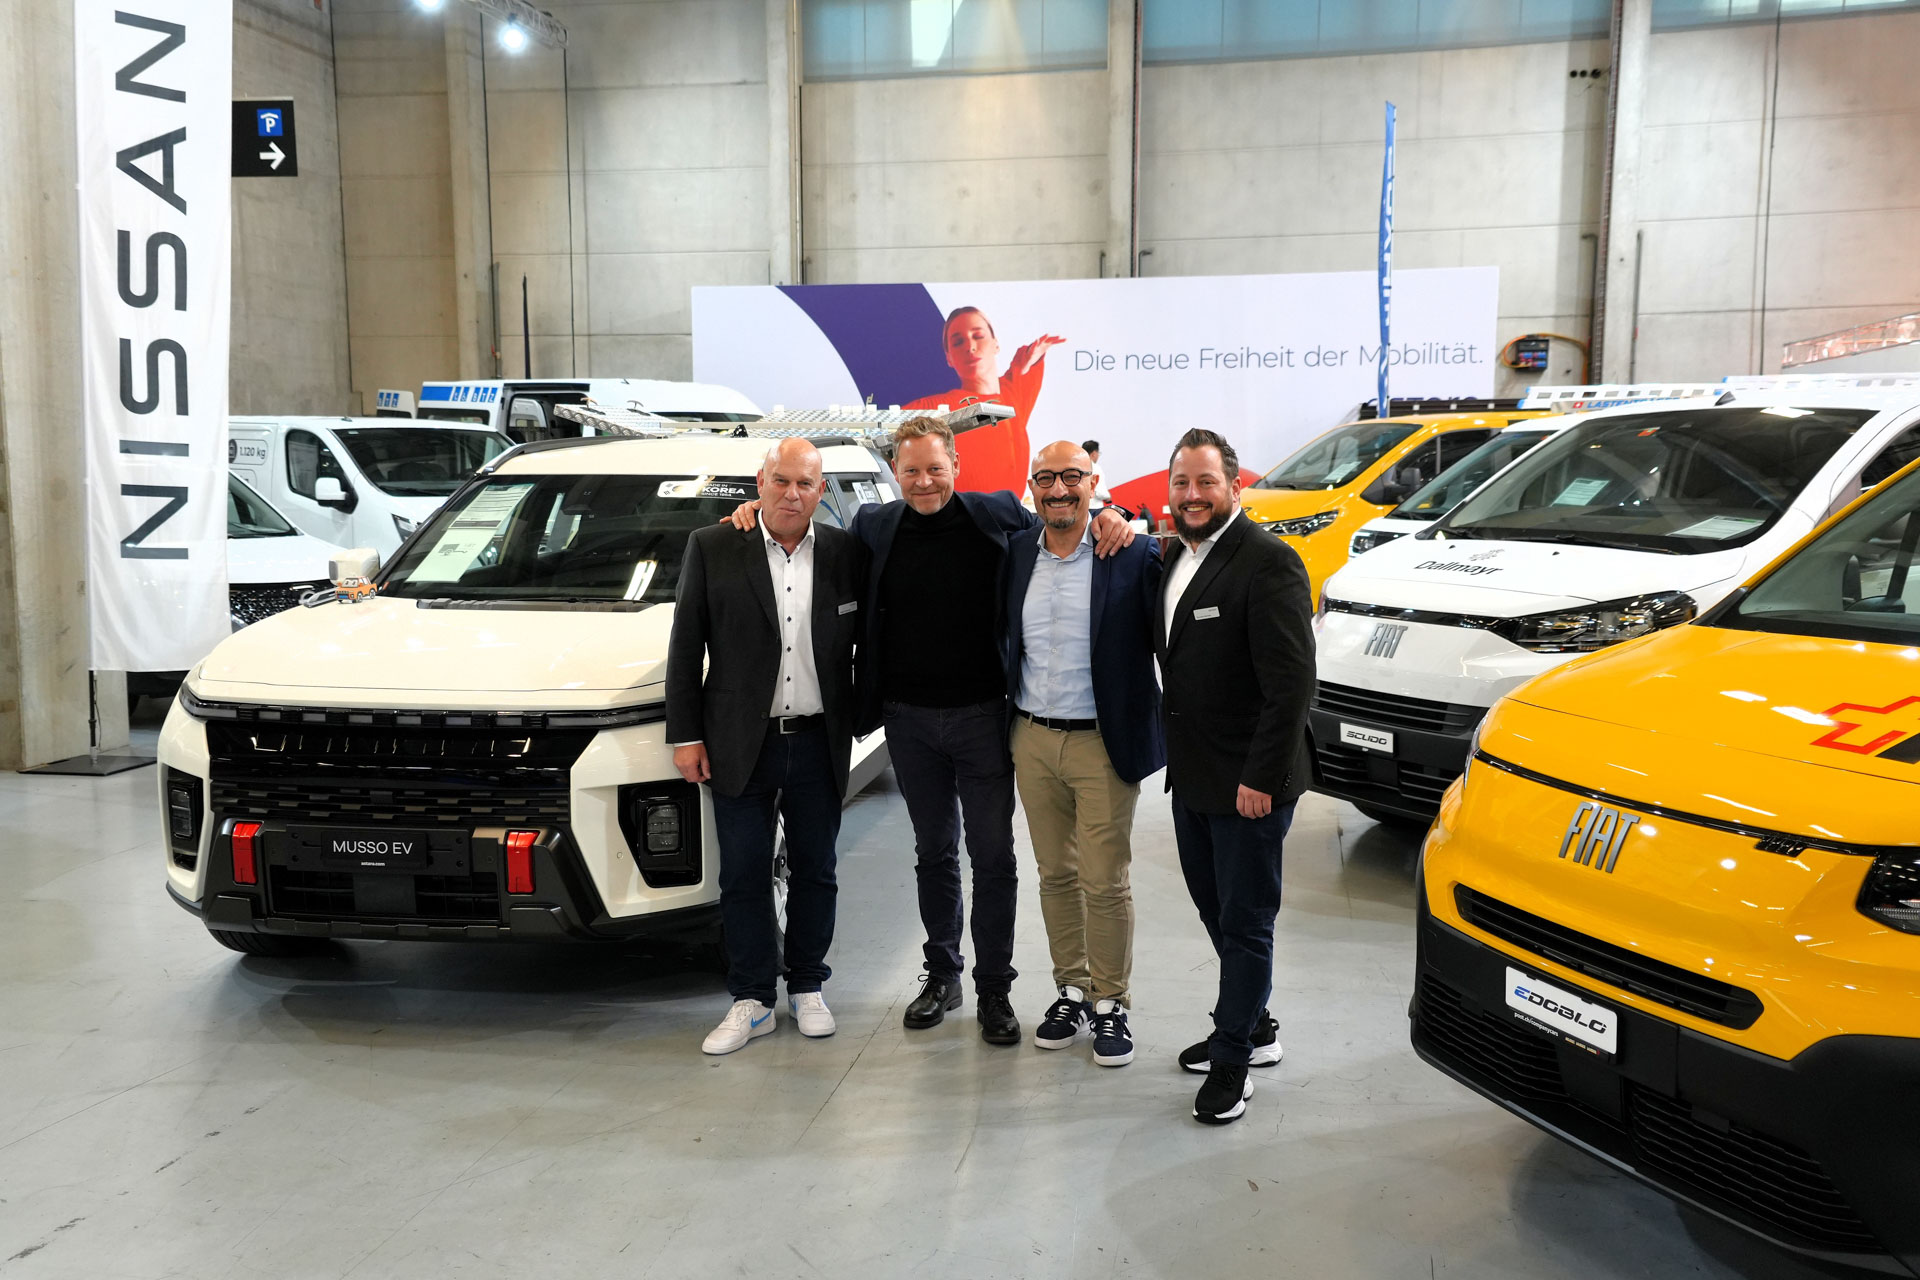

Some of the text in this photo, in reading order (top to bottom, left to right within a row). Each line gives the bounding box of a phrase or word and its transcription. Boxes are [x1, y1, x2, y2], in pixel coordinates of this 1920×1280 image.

[115, 10, 189, 560] NISSAN
[1074, 349, 1116, 371] Die
[1125, 354, 1189, 370] neue
[1200, 347, 1295, 369] Freiheit
[1304, 346, 1348, 367] der
[256, 447, 266, 460] kg
[702, 487, 746, 495] KOREA
[1413, 561, 1504, 575] Dallmayr
[1364, 623, 1409, 659] FIAT
[1346, 731, 1387, 746] SCUDO
[1559, 802, 1641, 874] FIAT
[333, 840, 413, 855] MUSSO EV
